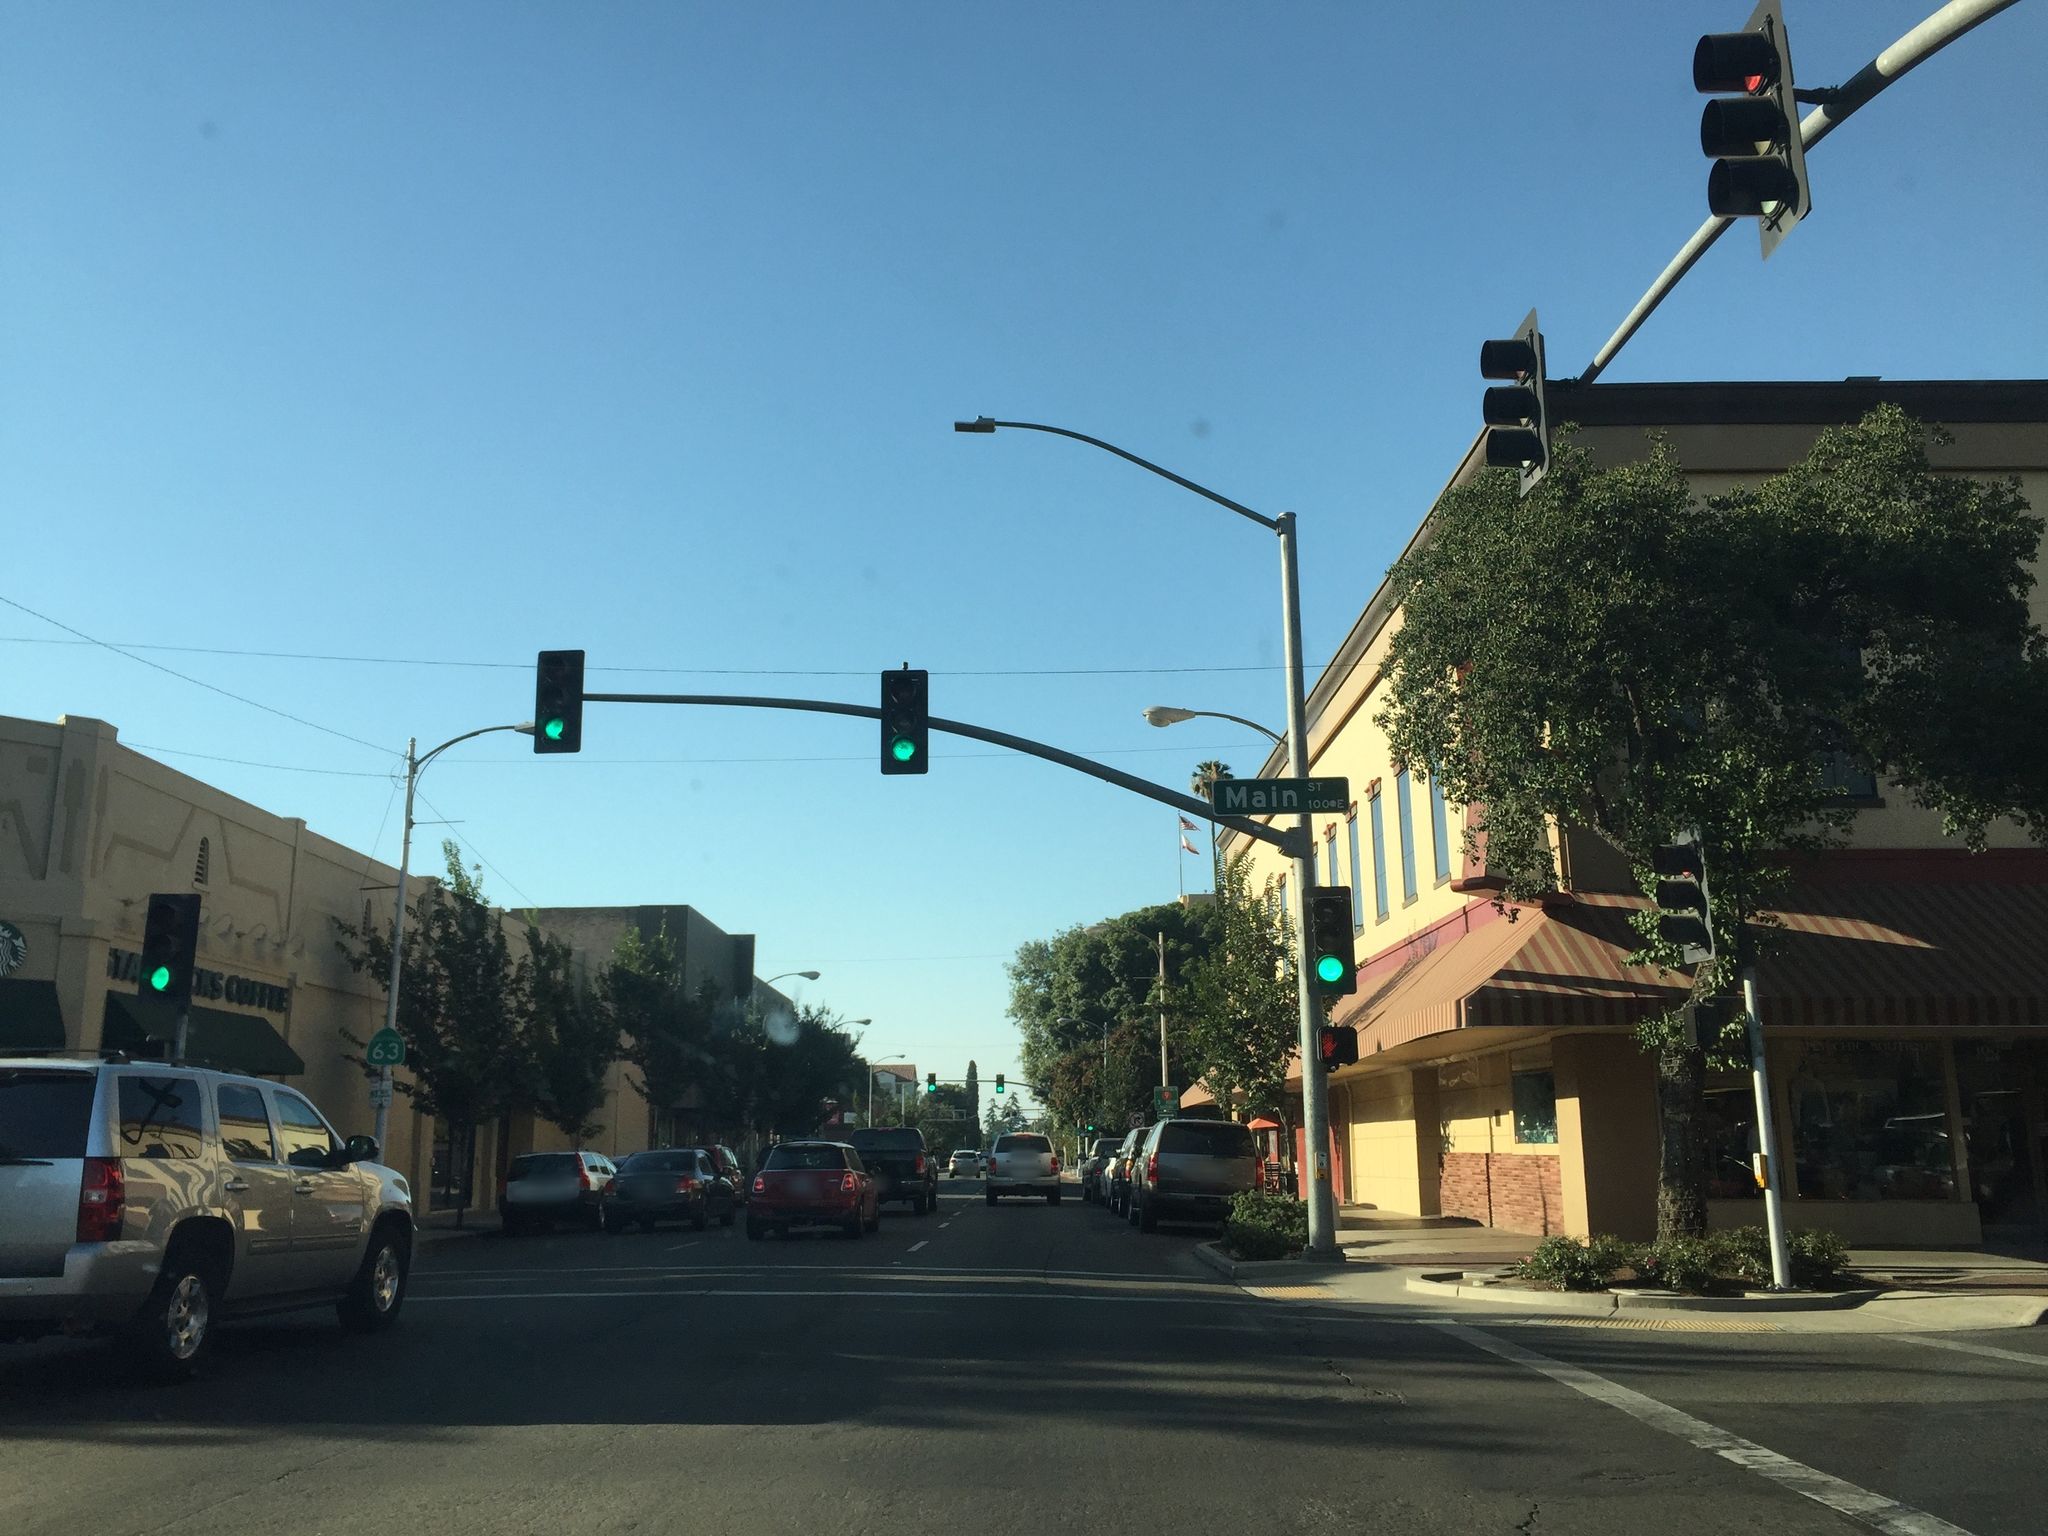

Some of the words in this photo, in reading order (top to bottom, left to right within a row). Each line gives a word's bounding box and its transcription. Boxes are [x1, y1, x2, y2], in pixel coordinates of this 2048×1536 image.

[1226, 786, 1298, 809] Main
[1307, 782, 1323, 792] ST
[372, 1042, 400, 1060] 63
